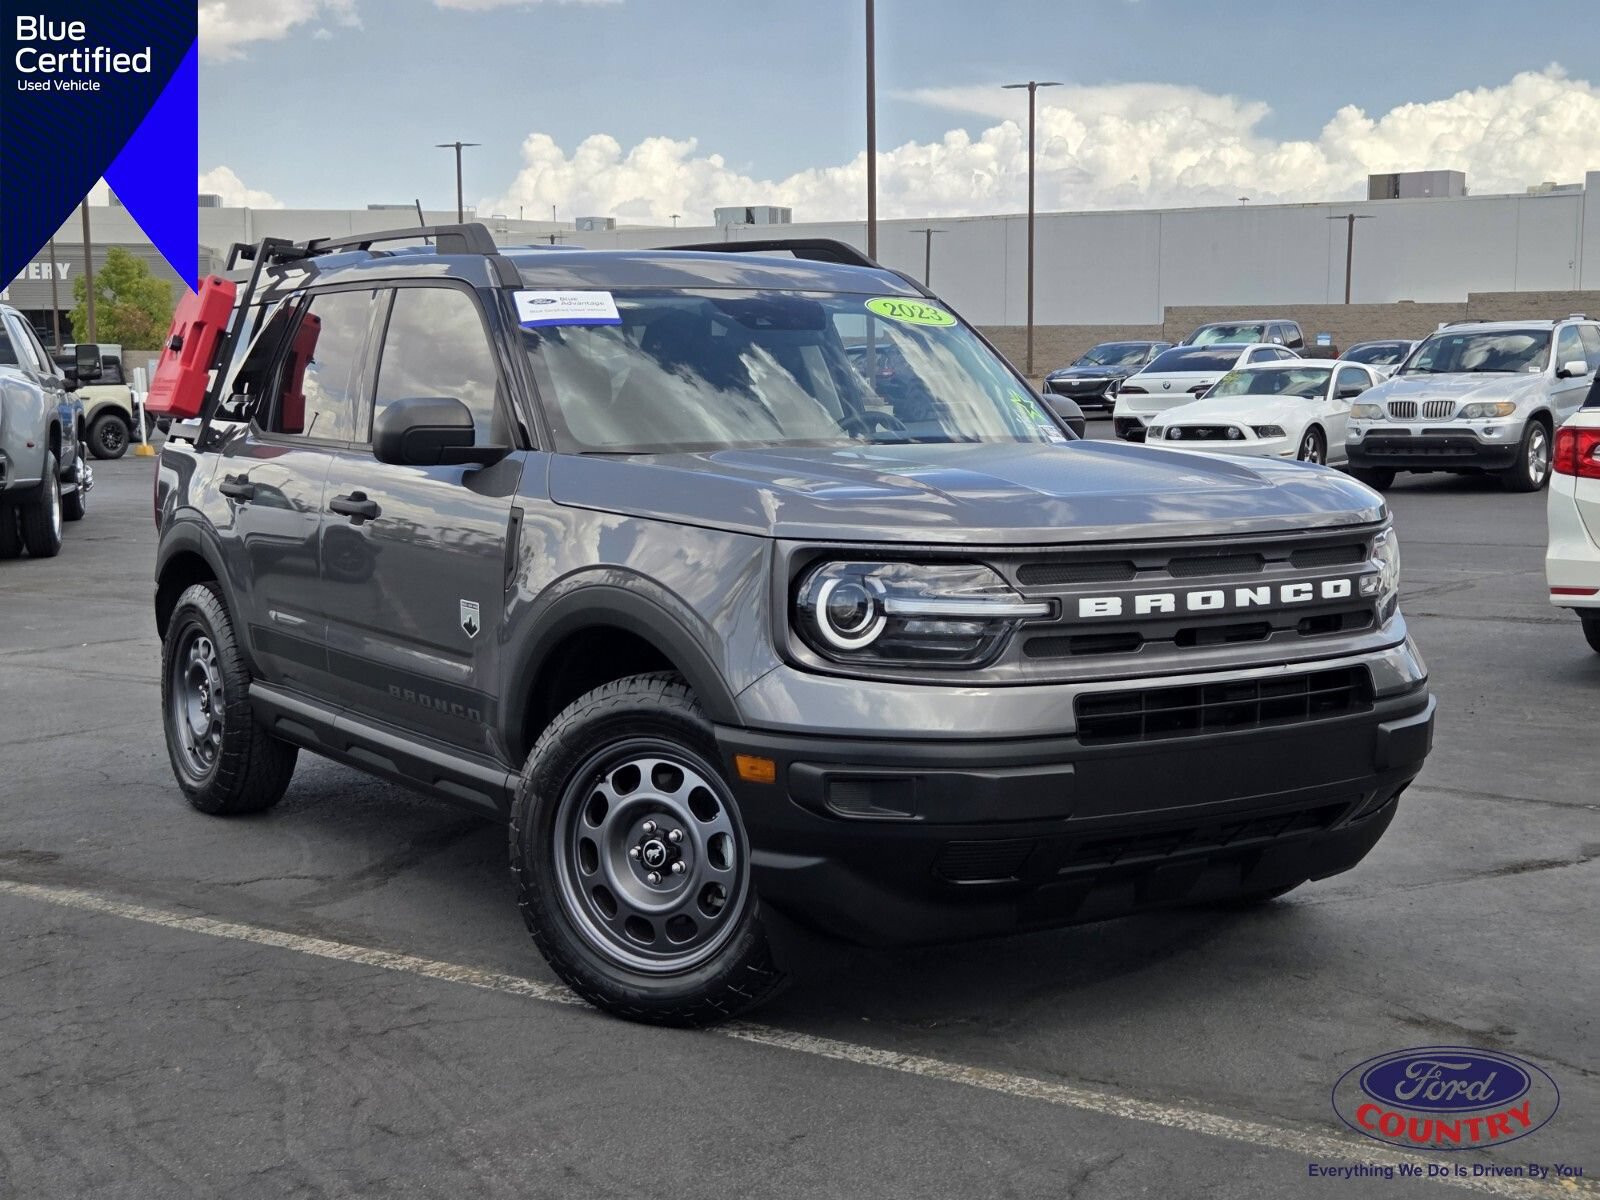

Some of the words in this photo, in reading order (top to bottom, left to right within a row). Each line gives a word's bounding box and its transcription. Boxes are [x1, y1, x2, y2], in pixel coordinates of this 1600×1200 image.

[883, 302, 943, 322] 2023
[1079, 579, 1351, 618] BRONCO
[388, 684, 480, 722] BRONCO
